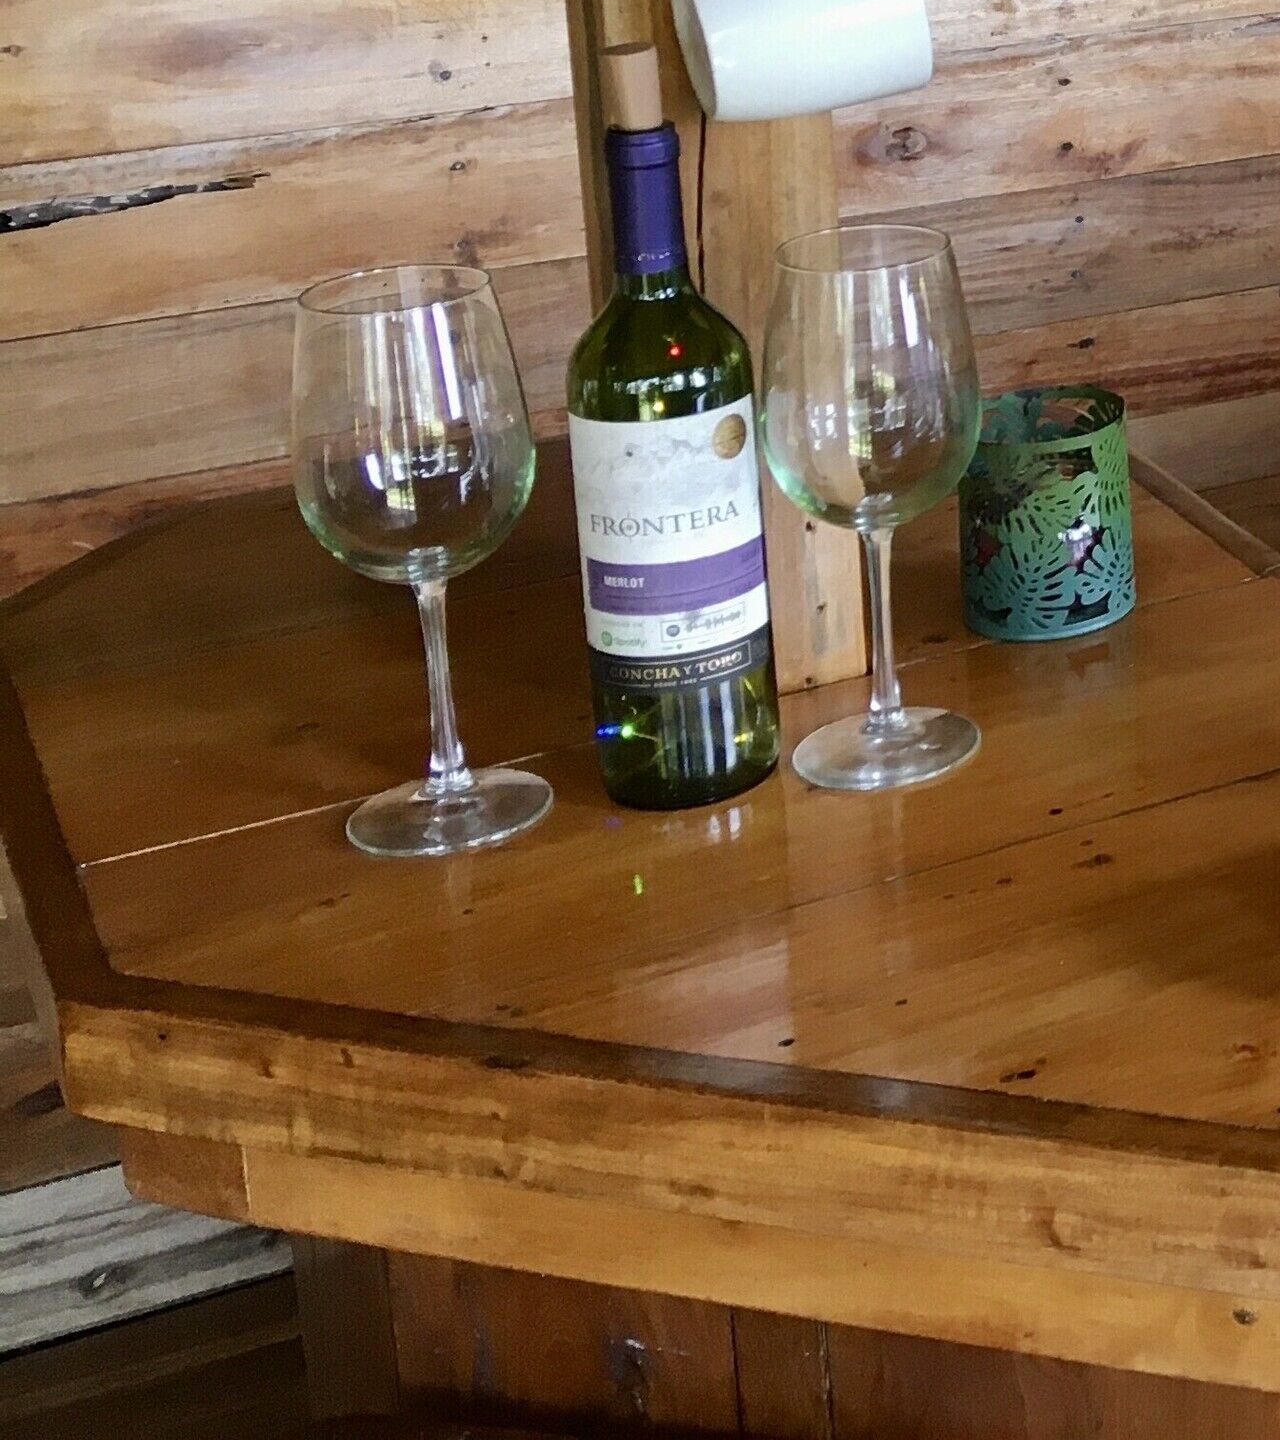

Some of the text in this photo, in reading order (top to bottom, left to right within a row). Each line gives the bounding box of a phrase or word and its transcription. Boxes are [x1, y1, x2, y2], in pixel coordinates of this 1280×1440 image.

[590, 500, 739, 537] FRONTERA
[604, 576, 645, 588] MERLOT
[609, 651, 742, 681] CONCHA Y TORO
